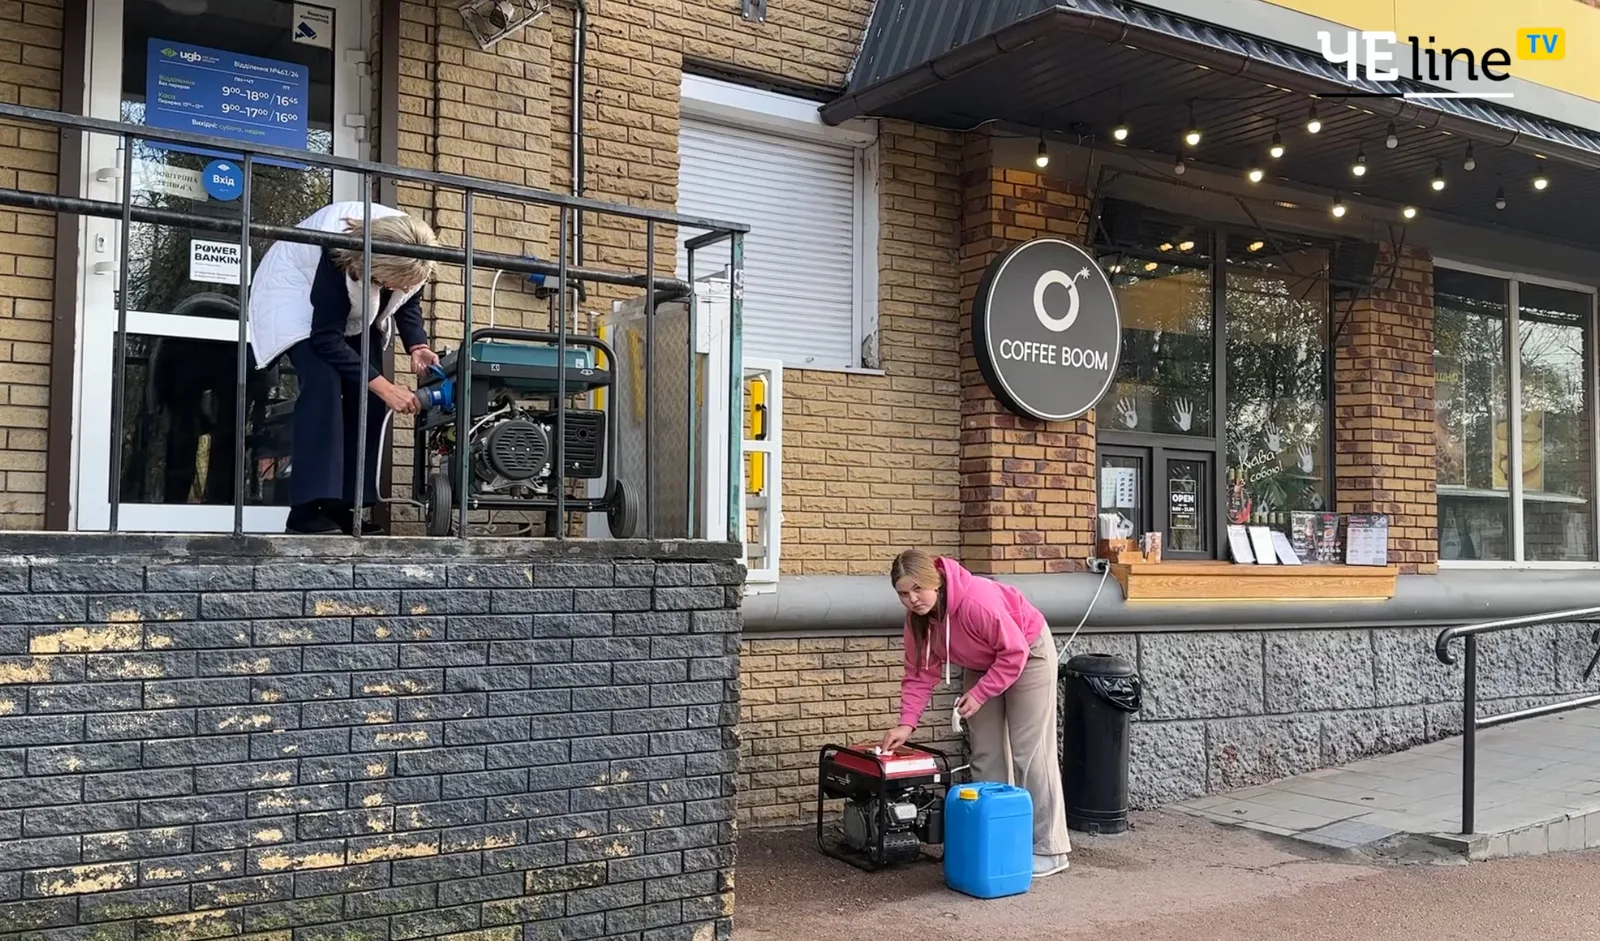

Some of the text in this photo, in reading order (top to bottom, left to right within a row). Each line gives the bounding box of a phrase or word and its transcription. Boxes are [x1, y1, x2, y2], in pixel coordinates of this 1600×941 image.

[180, 51, 202, 62] ugb
[233, 60, 269, 72] Відділення
[212, 174, 235, 187] Вхід
[195, 244, 237, 255] POWER
[194, 253, 242, 265] BANKIN
[1000, 339, 1108, 371] COFFEE BOOM
[1238, 449, 1275, 471] Кава
[1250, 460, 1283, 482] собою!
[1172, 493, 1194, 503] OPEN
